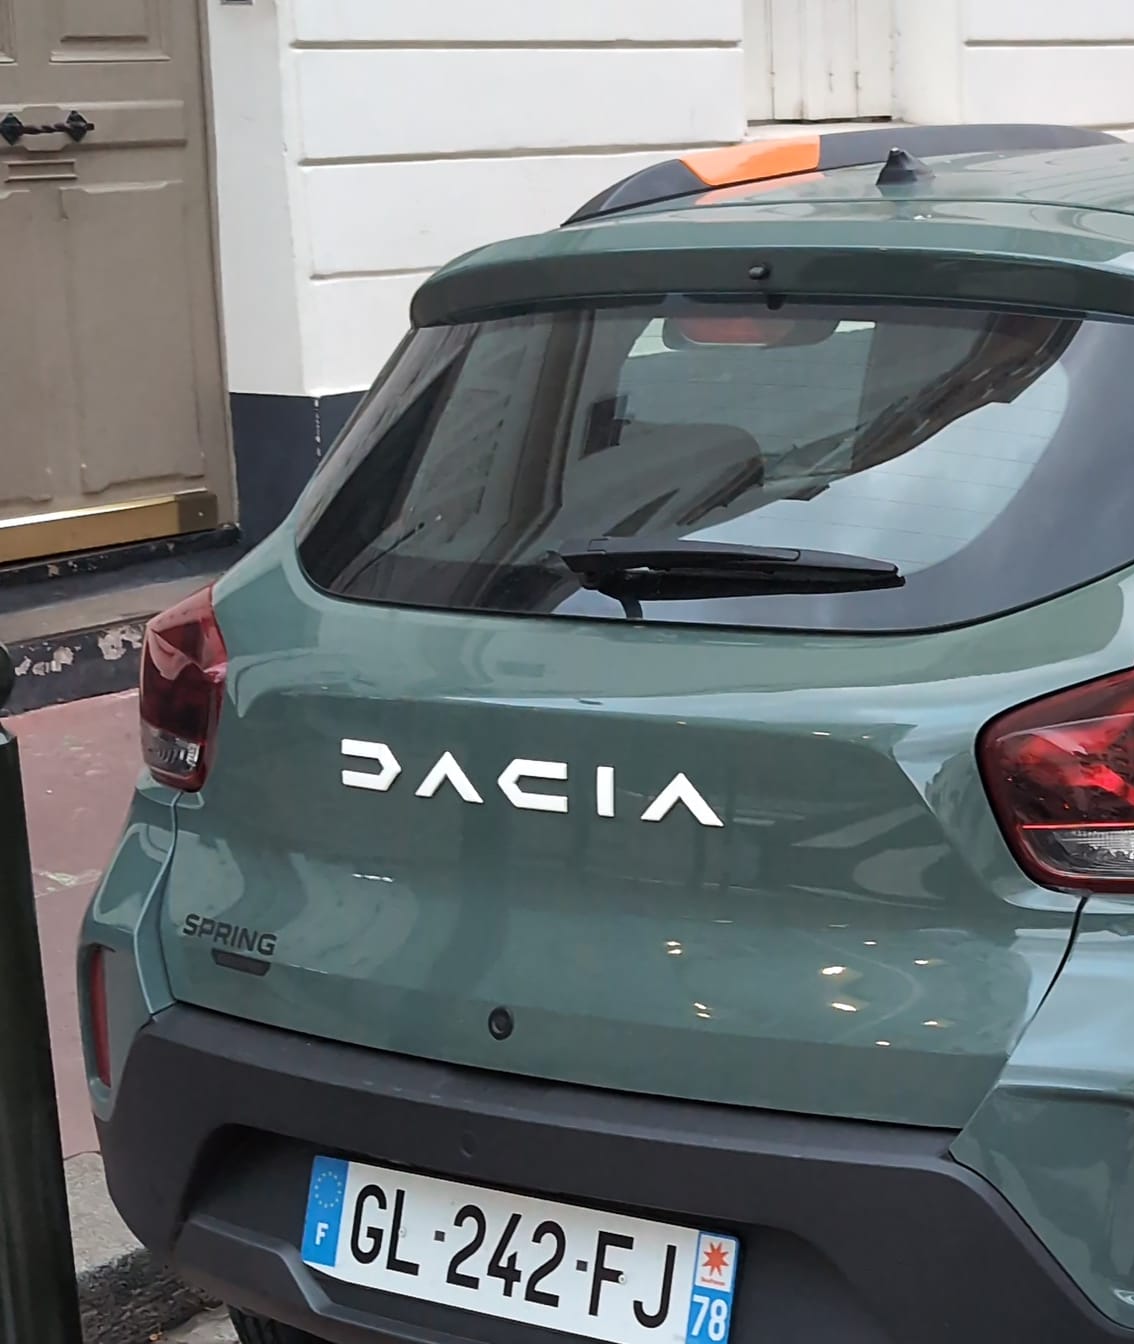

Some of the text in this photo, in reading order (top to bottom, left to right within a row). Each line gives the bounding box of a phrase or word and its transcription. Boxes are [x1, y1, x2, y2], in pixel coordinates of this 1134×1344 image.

[340, 738, 725, 827] DACIA
[182, 912, 278, 956] SPRING
[315, 1222, 329, 1246] F
[690, 1293, 728, 1342] 78
